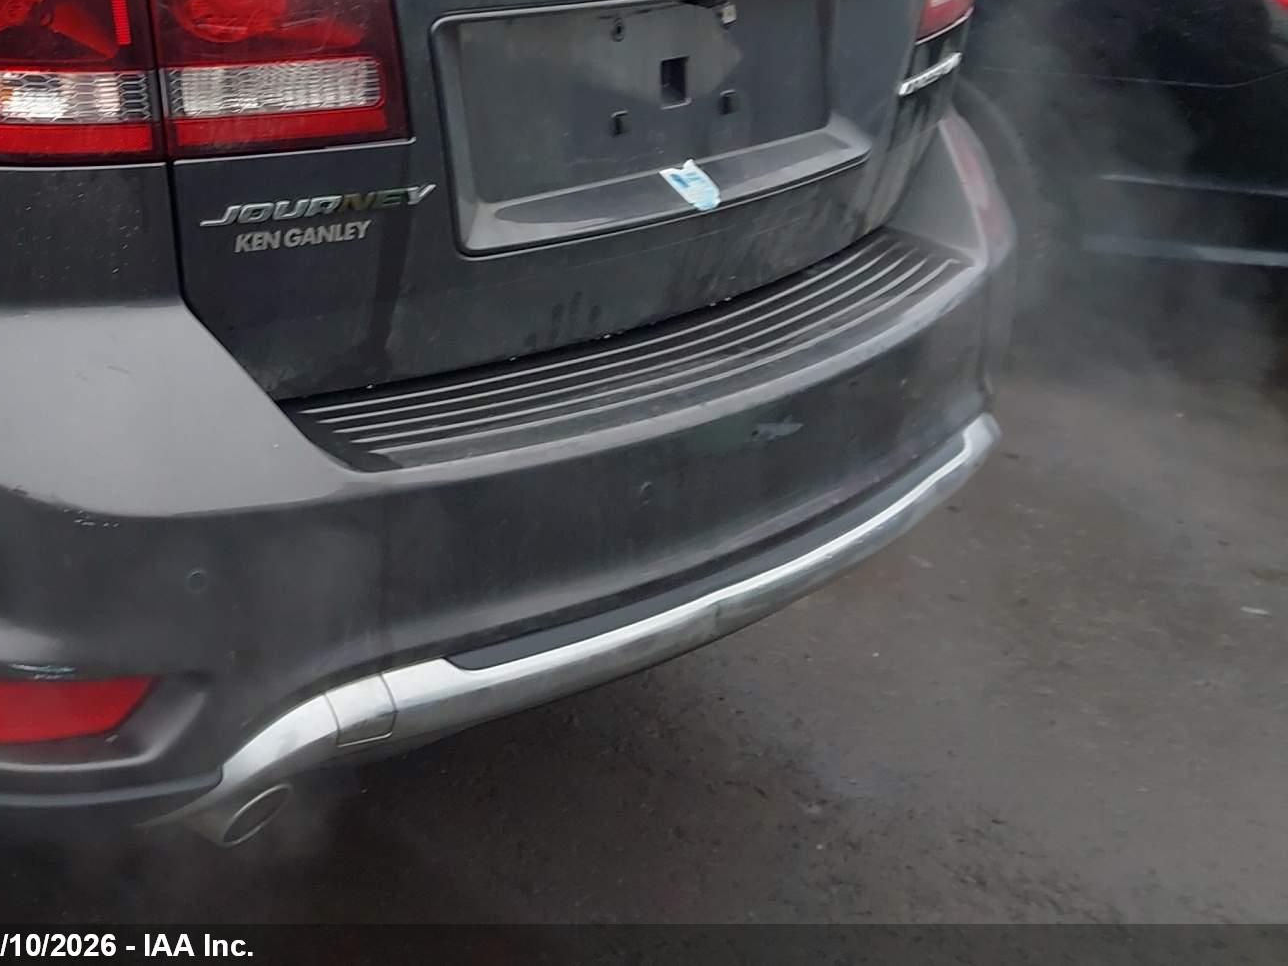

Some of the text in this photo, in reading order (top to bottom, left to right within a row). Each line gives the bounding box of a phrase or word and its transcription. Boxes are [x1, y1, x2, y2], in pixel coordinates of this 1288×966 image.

[199, 183, 438, 227] JOURNEY
[235, 219, 372, 253] KEN GANLEY
